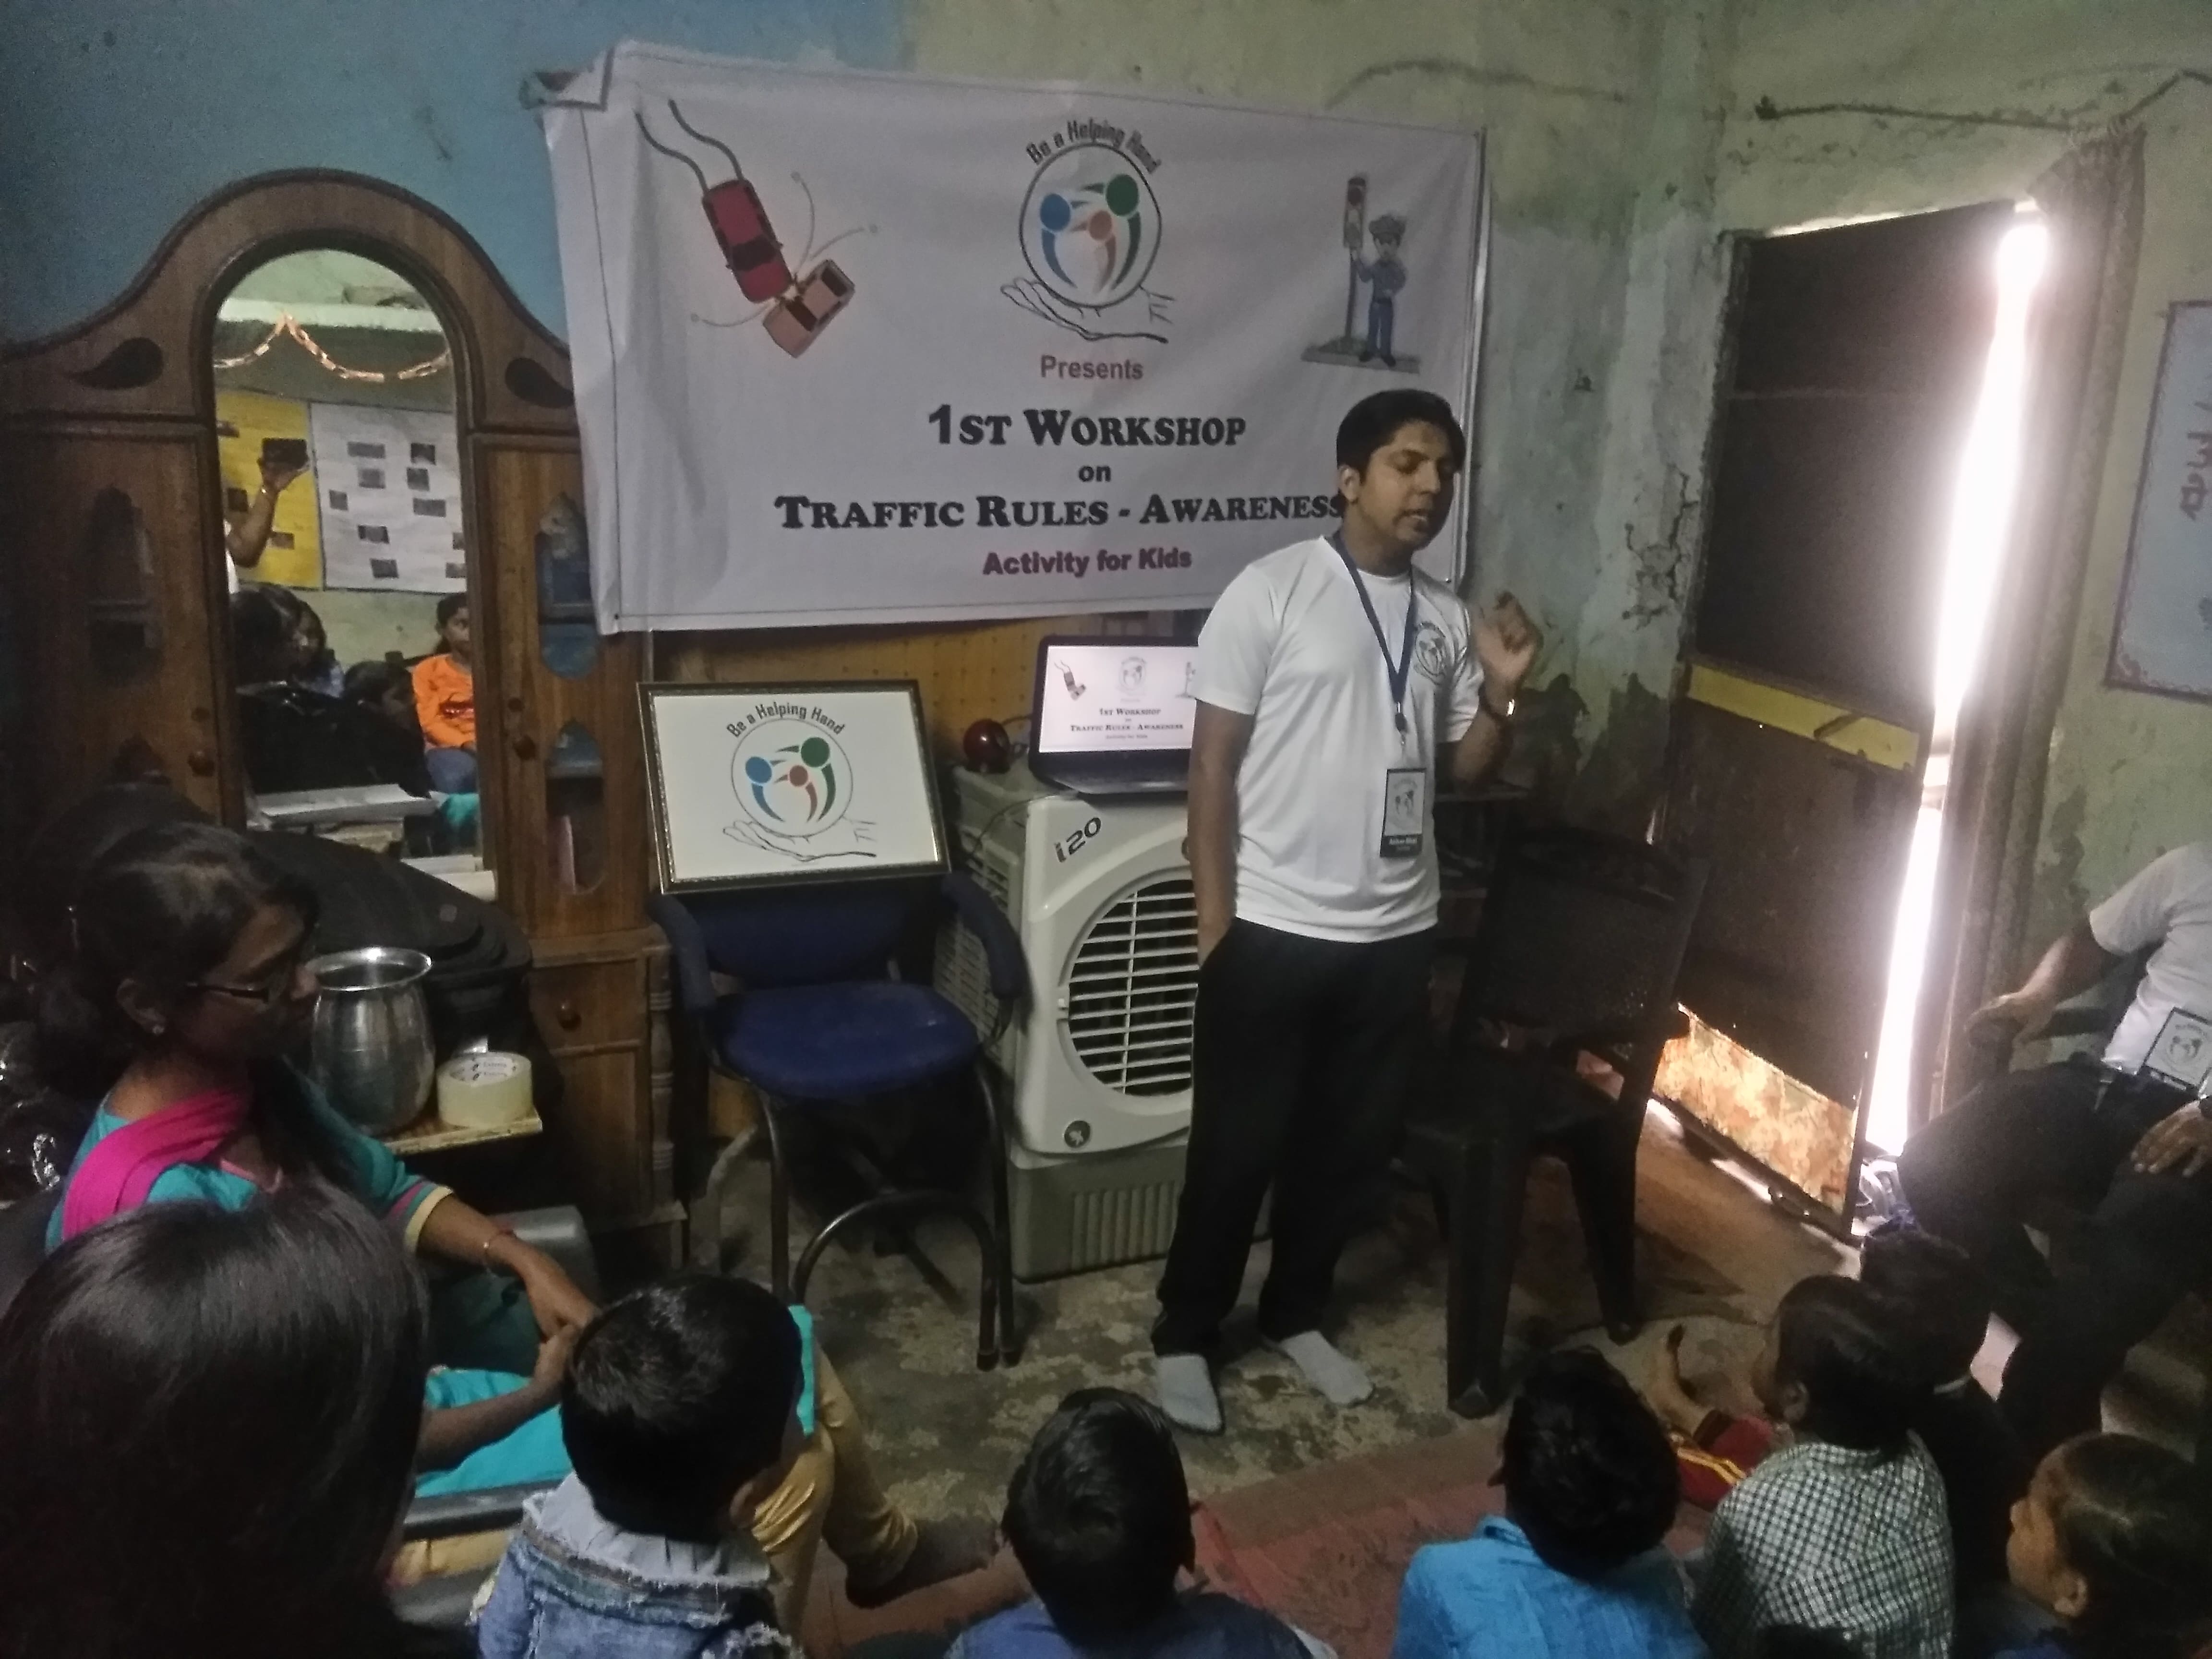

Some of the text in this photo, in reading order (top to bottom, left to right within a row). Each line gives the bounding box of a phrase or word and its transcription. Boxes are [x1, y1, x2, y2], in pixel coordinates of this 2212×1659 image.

[1025, 140, 1051, 165] Be
[1053, 132, 1064, 148] a
[1041, 354, 1144, 380] Presents
[928, 405, 1246, 446] 1ST WORKSHOP
[1078, 465, 1112, 482] on
[774, 495, 965, 529] TRAFFIC
[976, 495, 1108, 527] RULES
[982, 546, 1192, 577] Activity for Kids
[726, 701, 845, 737] Be a Helping Hand
[1054, 817, 1102, 863] i20
